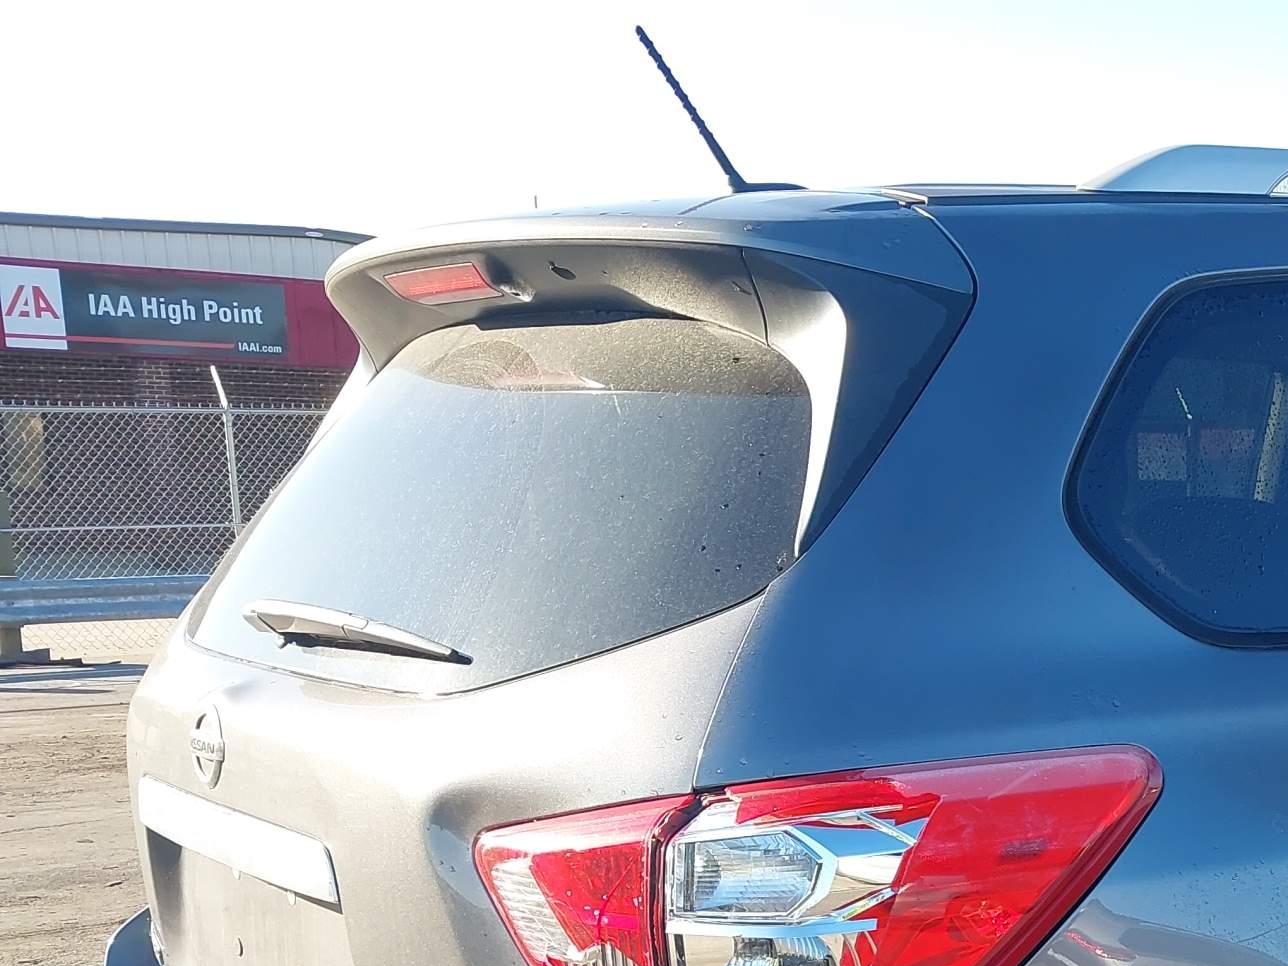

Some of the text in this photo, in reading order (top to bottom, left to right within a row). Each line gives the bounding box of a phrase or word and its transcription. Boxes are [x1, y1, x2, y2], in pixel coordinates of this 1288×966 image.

[88, 293, 263, 325] IAA High Point
[238, 341, 282, 353] IAAI.com
